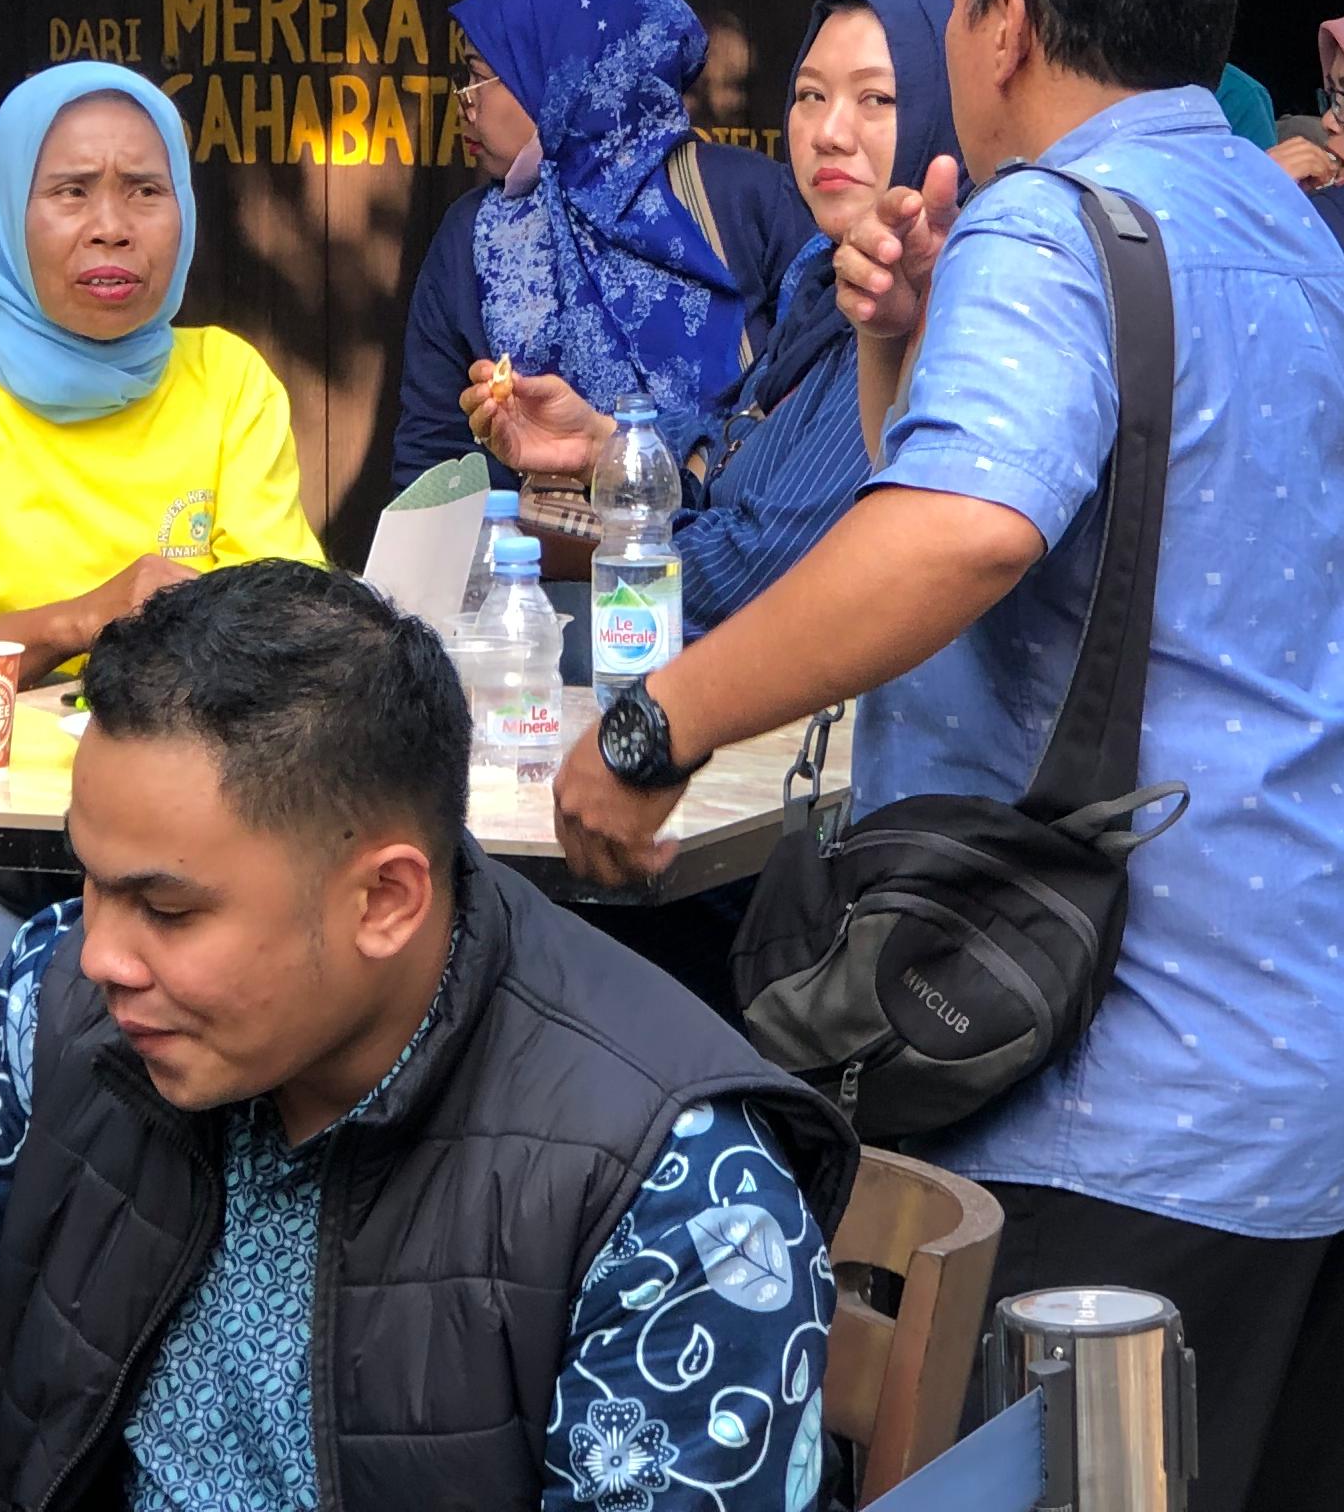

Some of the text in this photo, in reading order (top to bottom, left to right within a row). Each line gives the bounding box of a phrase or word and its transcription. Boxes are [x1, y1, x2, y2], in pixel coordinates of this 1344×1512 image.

[48, 16, 143, 63] DARI
[616, 615, 633, 631] Le
[599, 628, 657, 644] Minerale
[531, 704, 548, 721] Le
